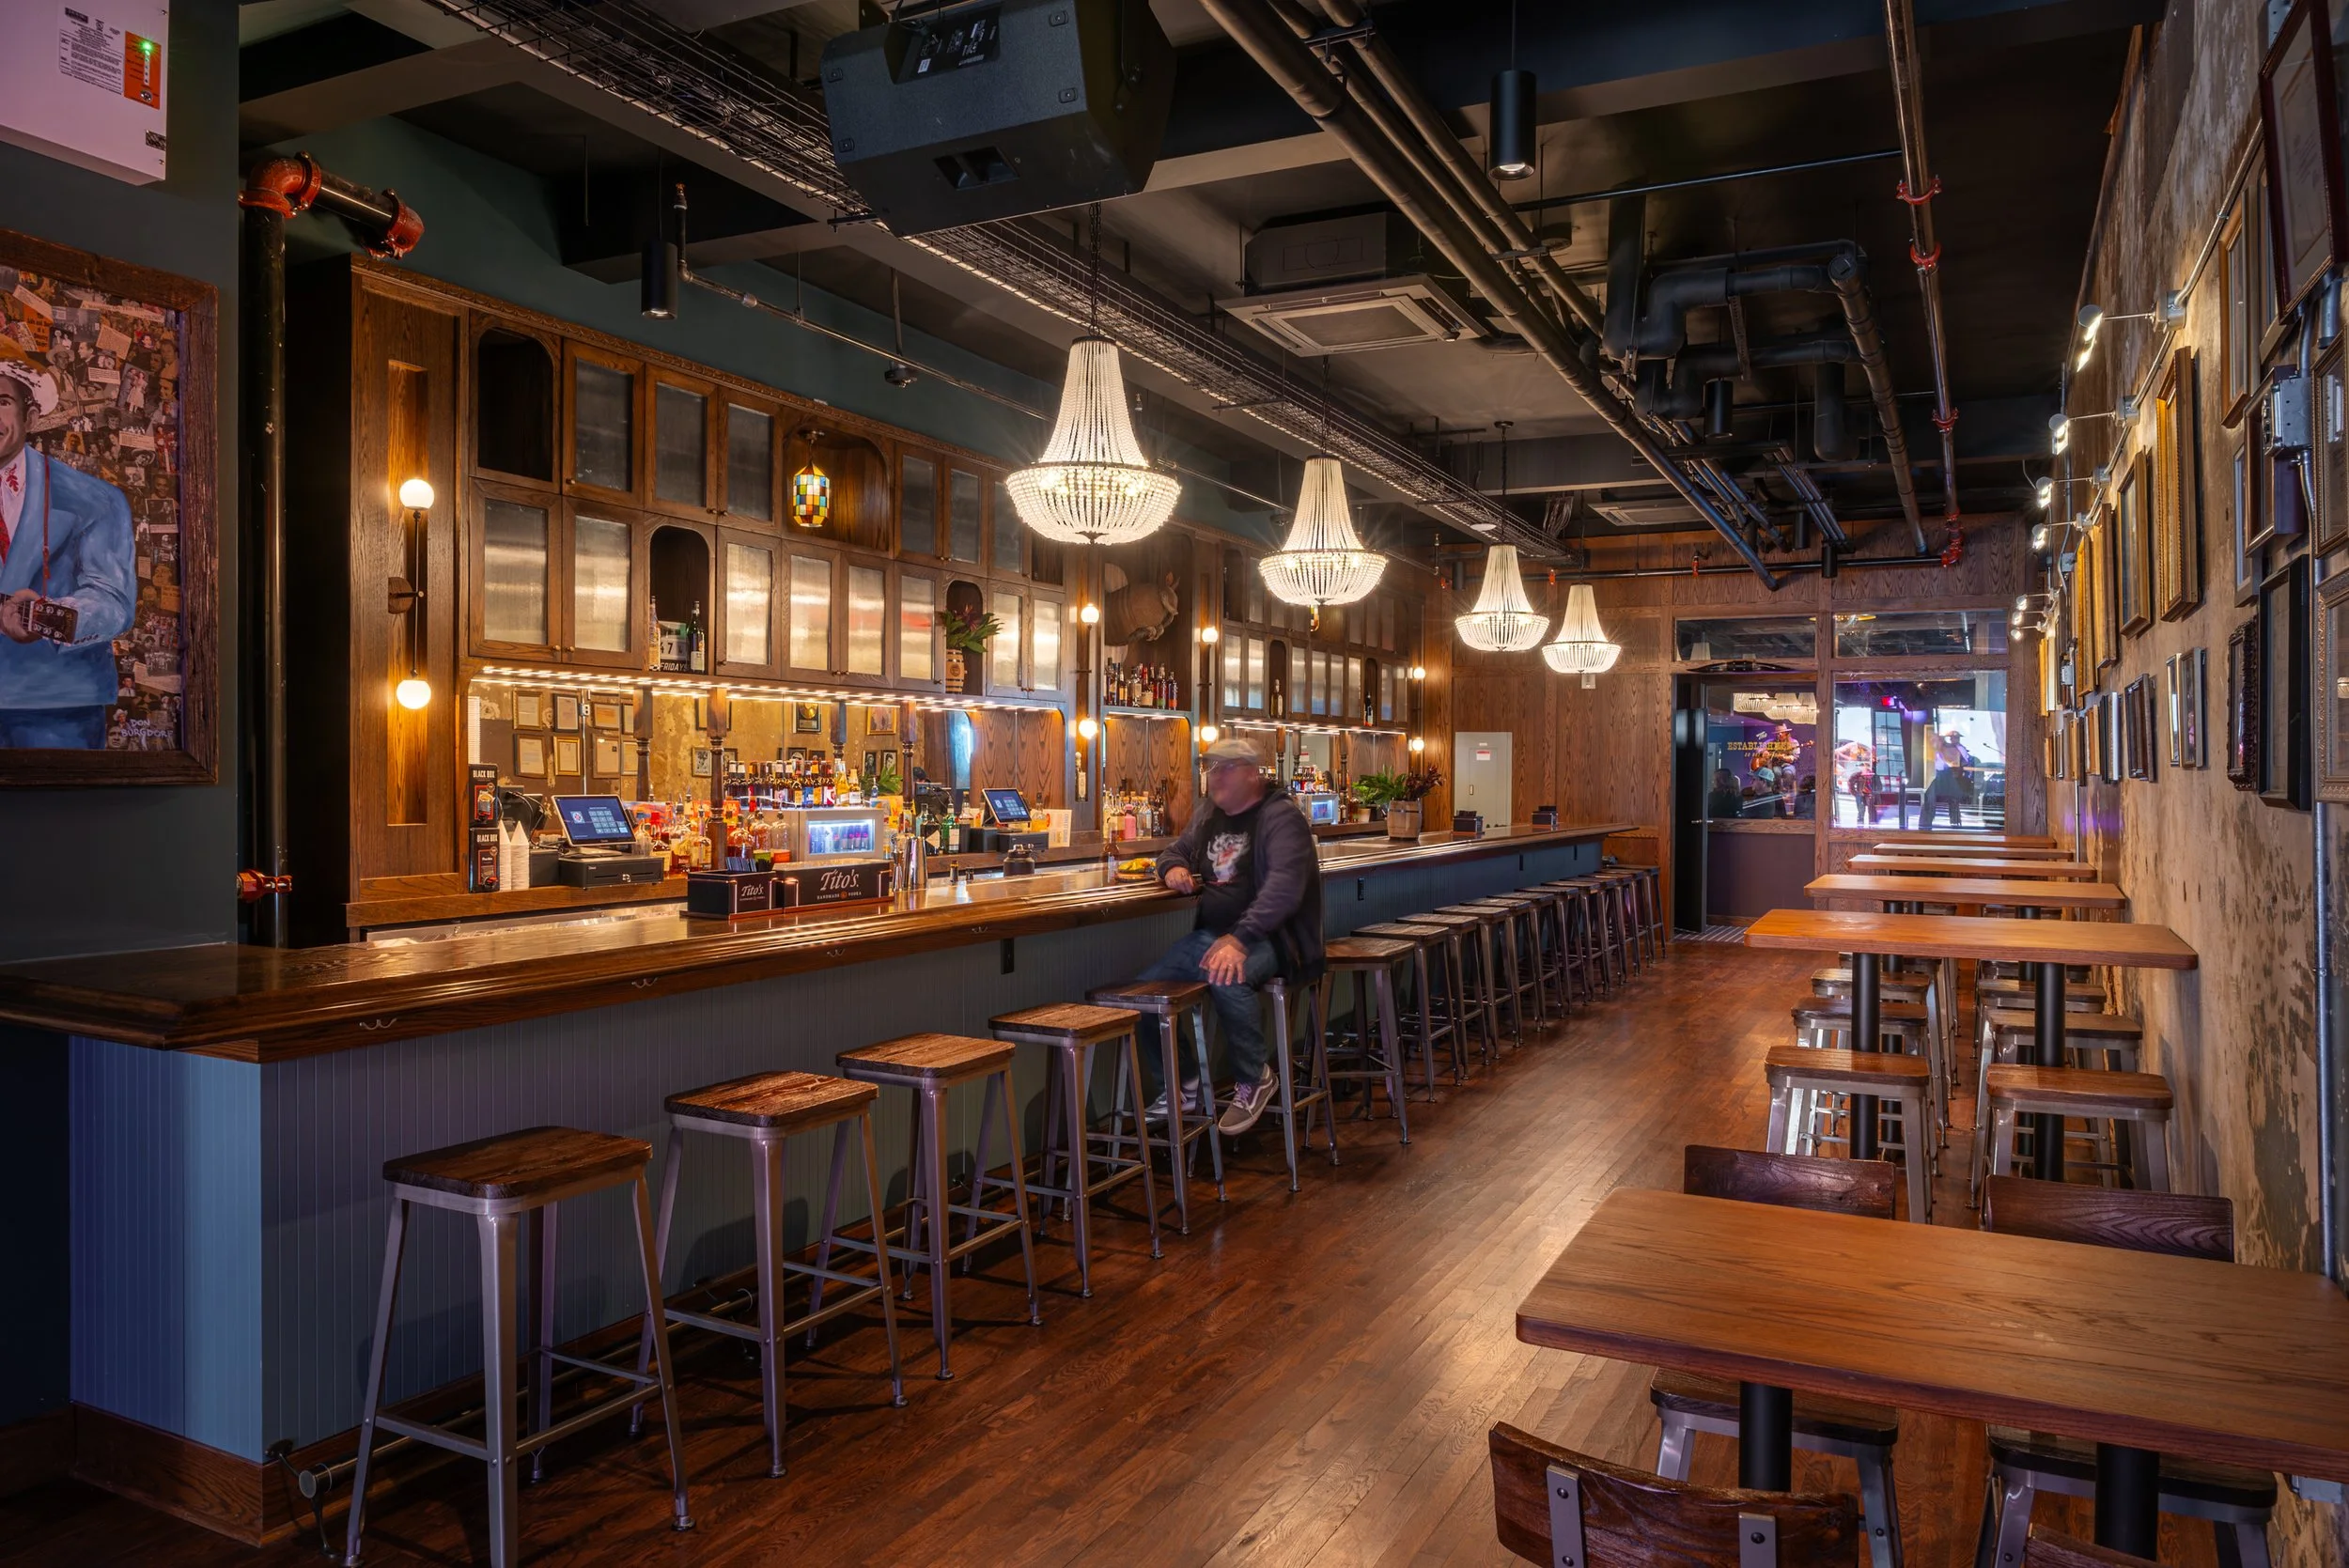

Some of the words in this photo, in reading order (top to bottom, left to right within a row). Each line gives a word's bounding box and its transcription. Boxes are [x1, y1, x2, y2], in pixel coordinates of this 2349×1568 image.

[120, 728, 174, 737] BURGDORF
[476, 834, 490, 843] BLACK
[490, 833, 498, 843] BOX
